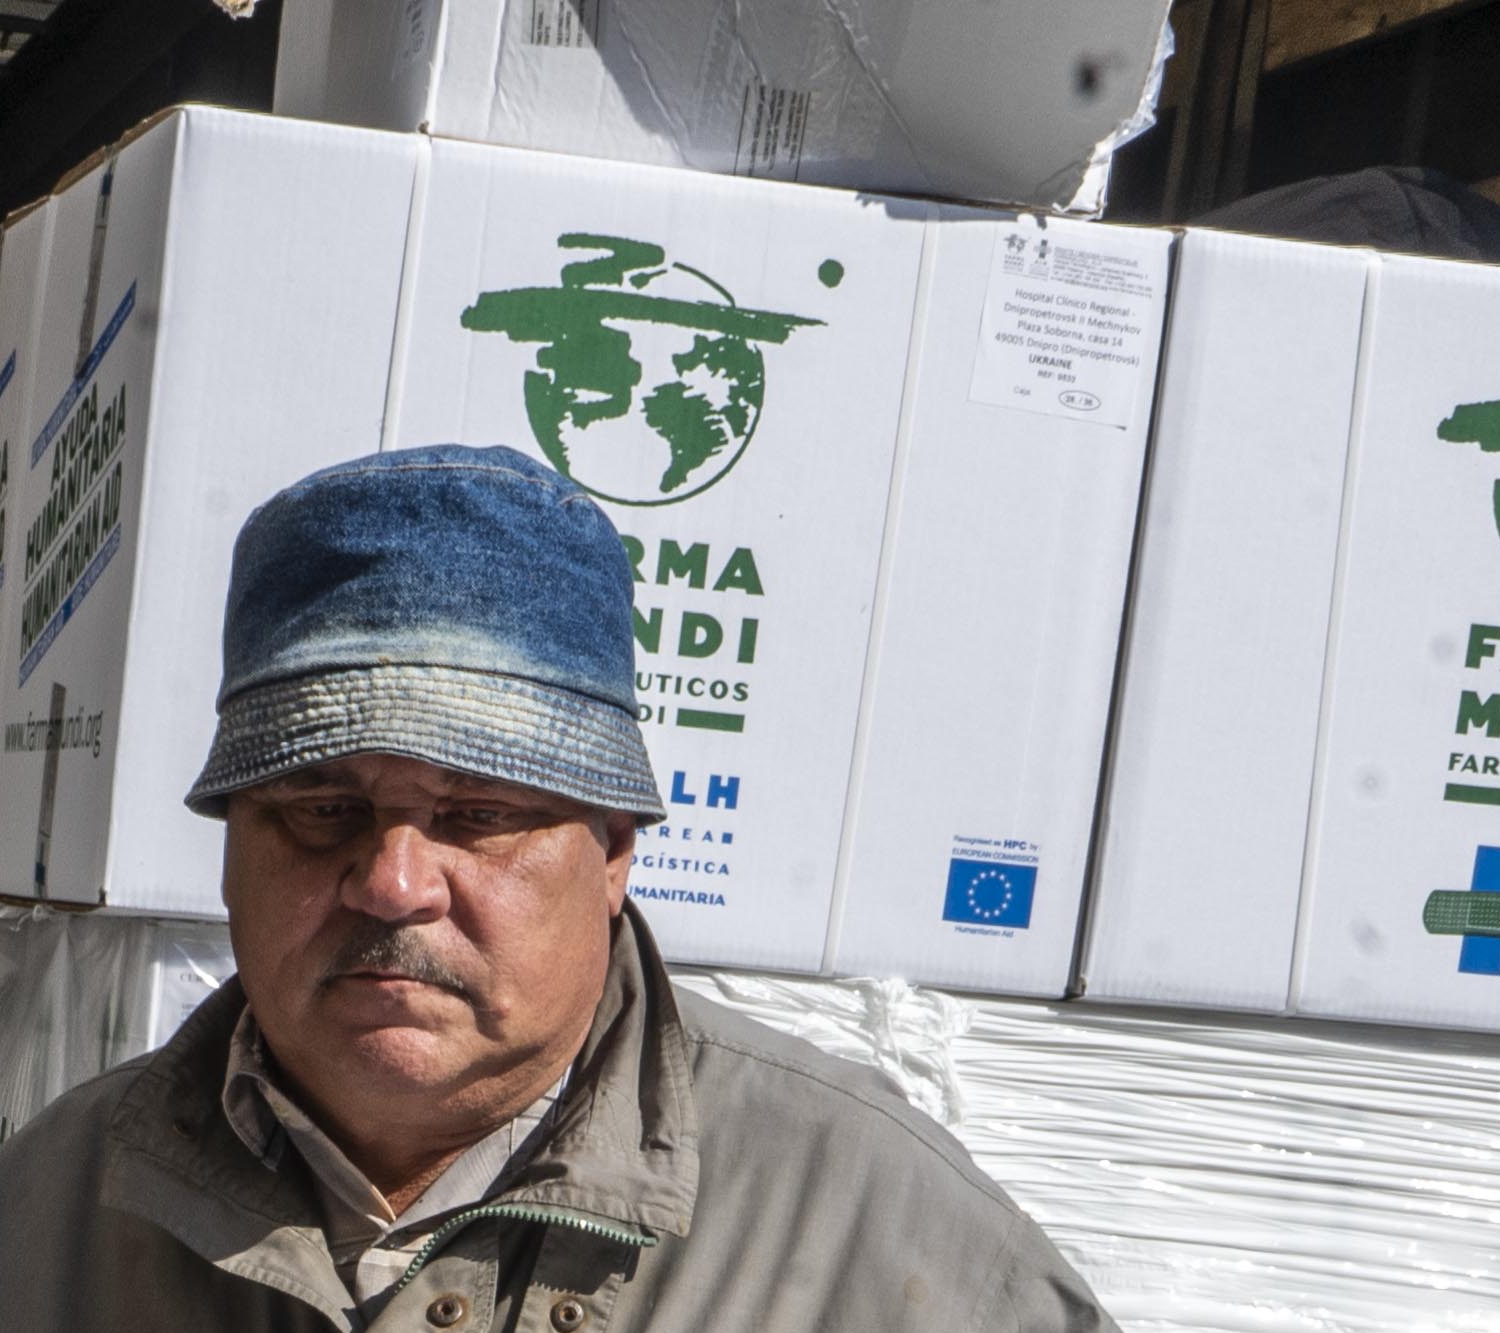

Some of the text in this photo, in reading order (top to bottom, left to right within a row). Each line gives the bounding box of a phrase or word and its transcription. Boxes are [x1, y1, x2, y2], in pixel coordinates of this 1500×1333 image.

[1004, 303, 1141, 335] Dnipropetrovsk Mechnykov
[1015, 288, 1130, 317] Hospital Clínico Regional
[995, 333, 1140, 368] 49005 Dnipro (Dnipropetrovsk)
[1018, 321, 1122, 347] Plaza Soborna, casa 14
[1029, 354, 1072, 369] UKRAINE
[51, 382, 97, 490] AYUDA
[25, 383, 126, 581] HUMANITARIA
[620, 535, 764, 596] RMA
[633, 606, 759, 664] NDI
[670, 771, 740, 809] LH
[1004, 839, 1027, 850] HPC
[629, 885, 725, 906] MANITARIA
